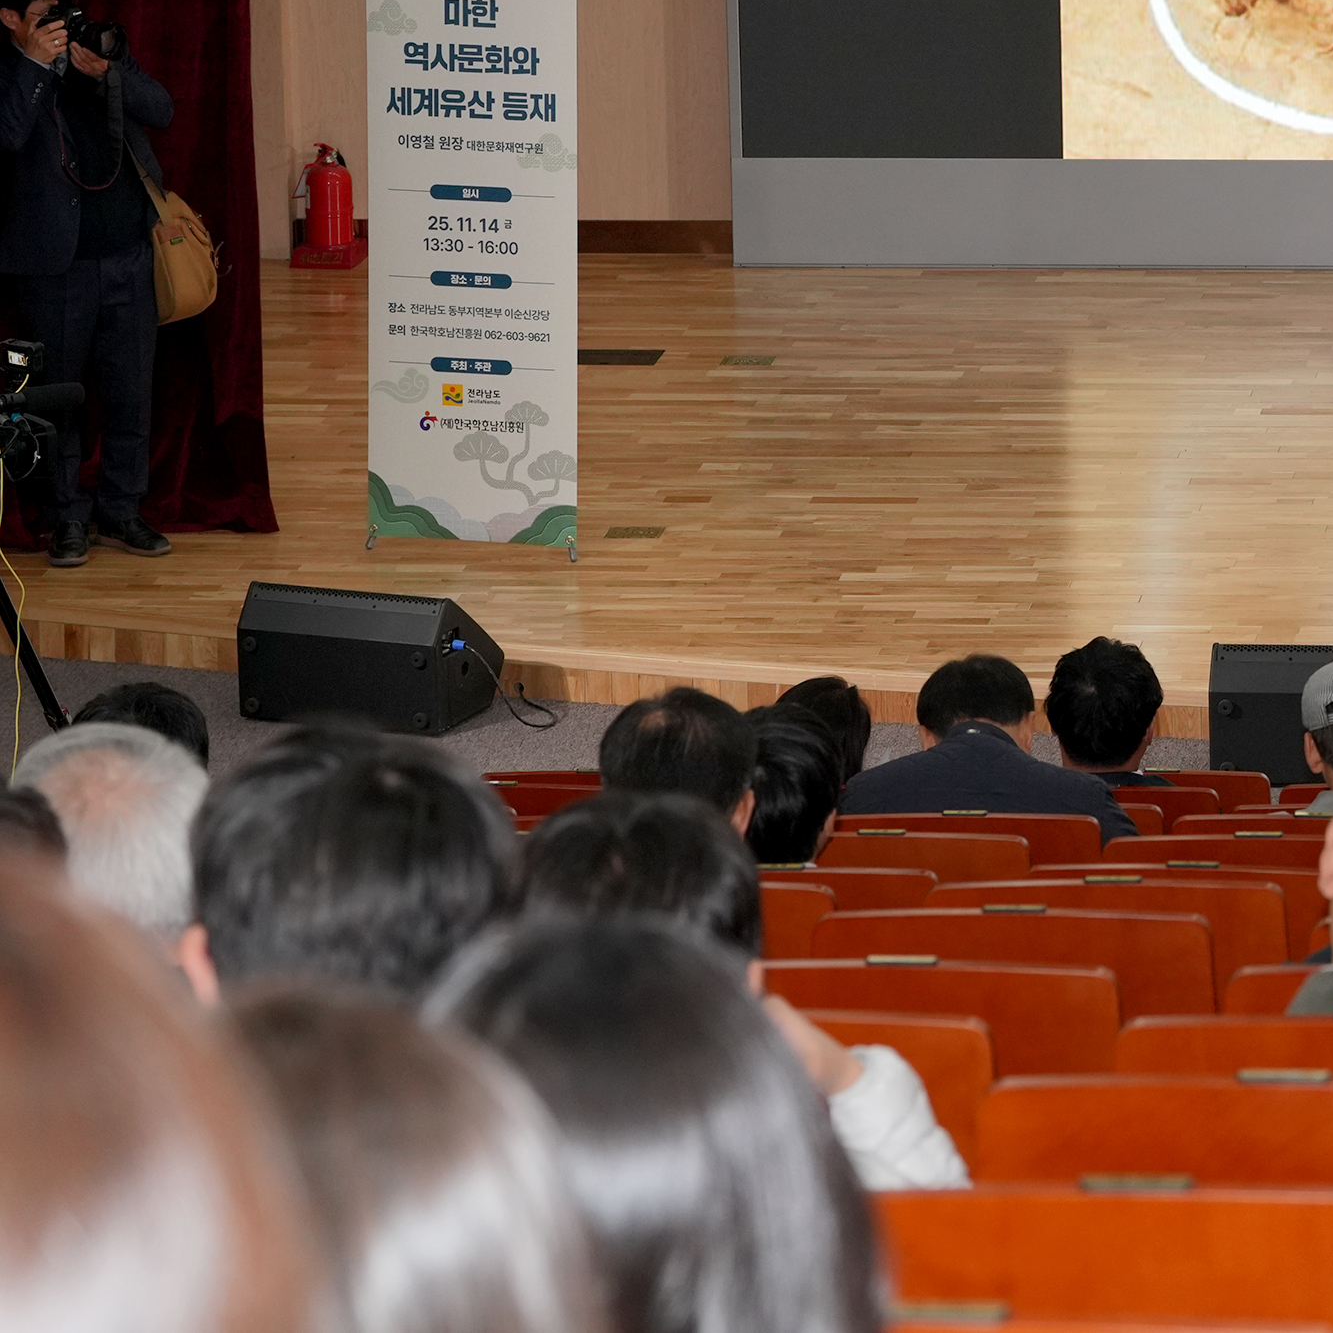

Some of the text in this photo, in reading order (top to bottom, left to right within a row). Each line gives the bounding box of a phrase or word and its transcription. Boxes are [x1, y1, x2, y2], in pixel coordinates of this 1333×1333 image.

[445, 0, 498, 28] 마한
[404, 42, 539, 75] 역사문화와
[387, 87, 555, 122] 세계유산 등재
[398, 134, 543, 154] 이영철 원장 대한문화재연구원
[462, 188, 479, 198] 일시
[504, 219, 512, 229] 금
[424, 238, 463, 252] 13:30
[478, 240, 518, 255] 16:00
[451, 275, 491, 285] 장소 문의
[388, 302, 550, 321] 장소 전라남도 동부지역본부 이순신강당
[388, 325, 550, 342] 문의 한국학호남진흥원 062-603-9621
[451, 360, 492, 372] 주최 주관
[468, 389, 500, 398] 전라남도
[440, 418, 524, 433] (재)한국학호남진흥원
